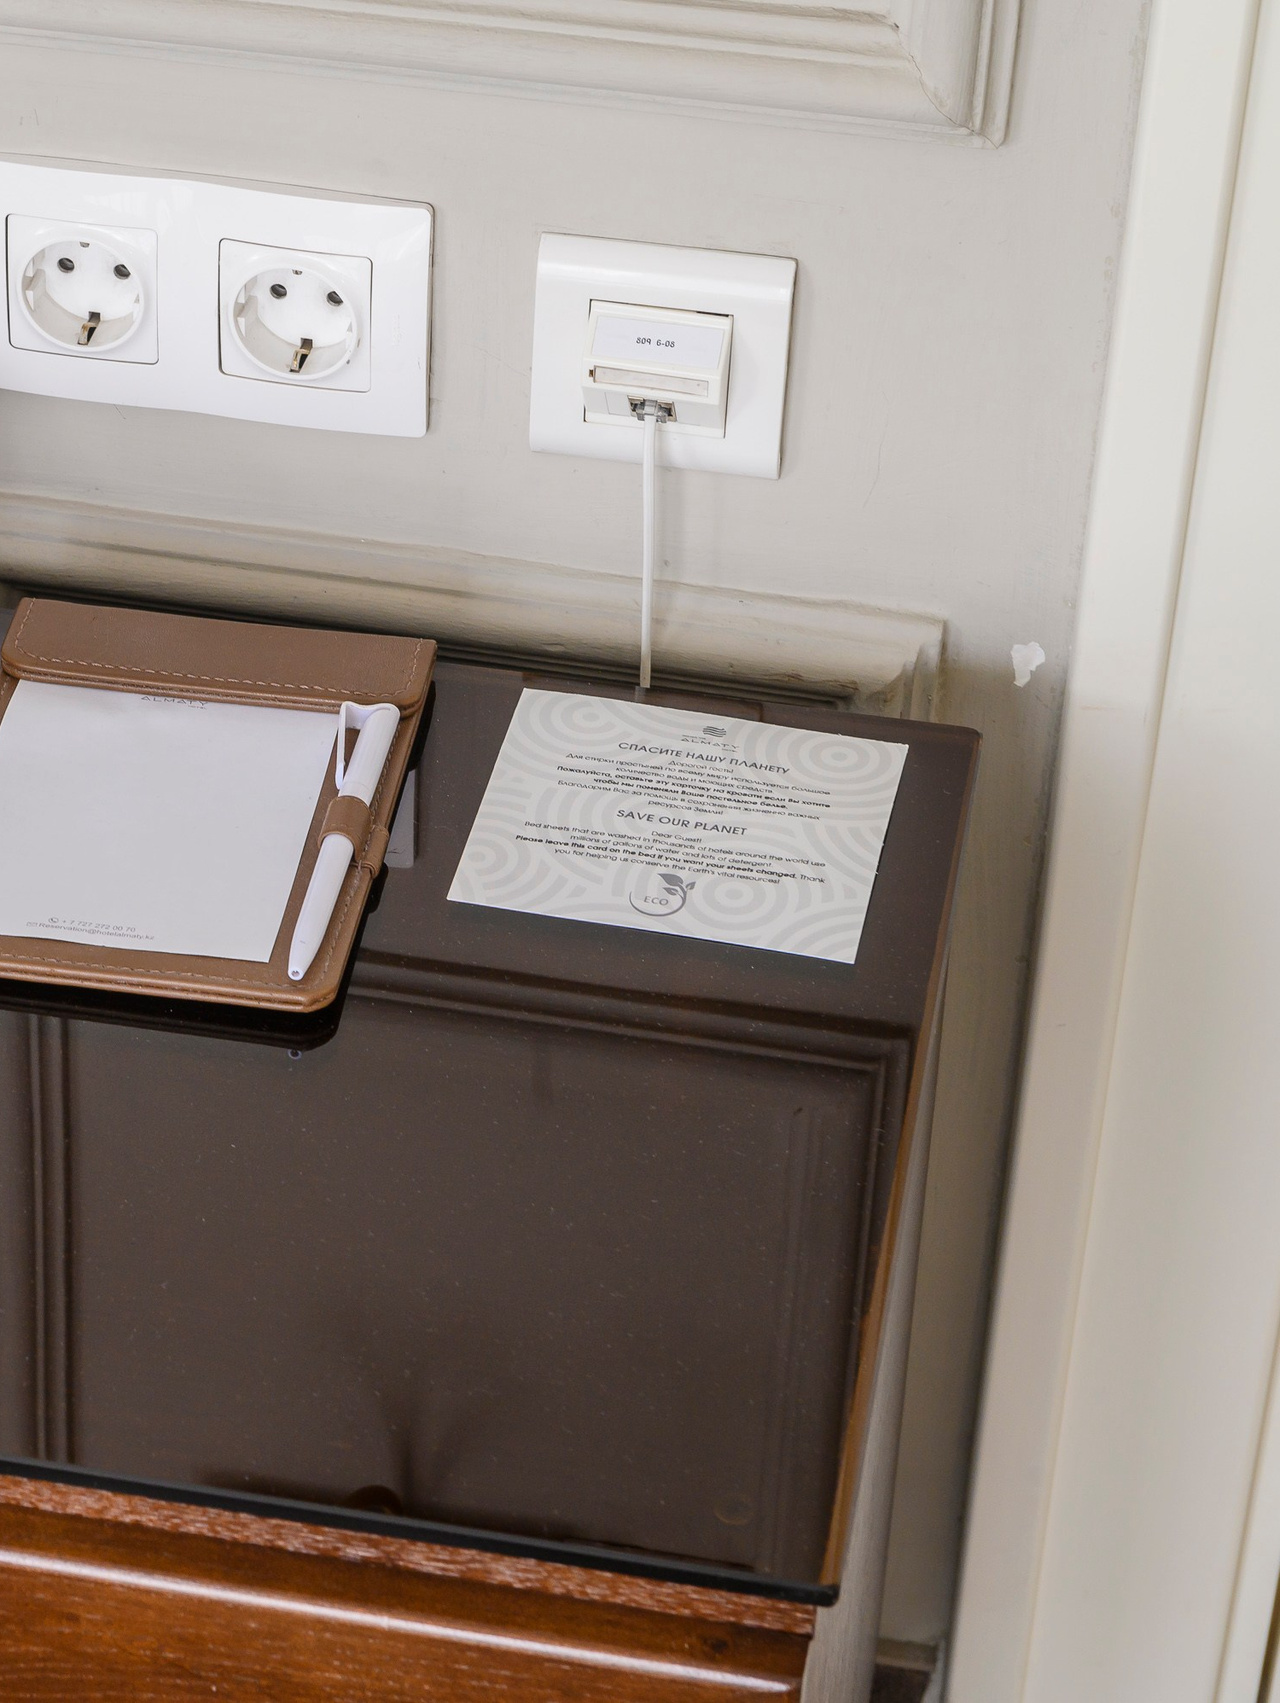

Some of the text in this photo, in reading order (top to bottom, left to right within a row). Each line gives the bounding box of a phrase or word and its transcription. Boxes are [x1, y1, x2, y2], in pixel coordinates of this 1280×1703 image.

[618, 742, 790, 774] СПАСИТЕ НАШУ ПЛАНЕТУ
[616, 809, 747, 835] SAVE OUR PLANET
[651, 830, 672, 838] Dear
[569, 835, 600, 843] millions
[612, 840, 642, 849] gallons
[607, 832, 641, 841] washed
[652, 838, 695, 849] thousands
[707, 847, 733, 855] hotels
[734, 851, 767, 859] around
[784, 857, 809, 865] world
[515, 834, 543, 843] Please
[544, 838, 569, 846] leave
[637, 850, 656, 858] bed
[755, 868, 796, 878] changed.
[800, 873, 825, 883] Thank
[585, 851, 618, 861] helping
[630, 858, 669, 868] conserve
[736, 874, 780, 884] resources!
[643, 895, 669, 906] ECO
